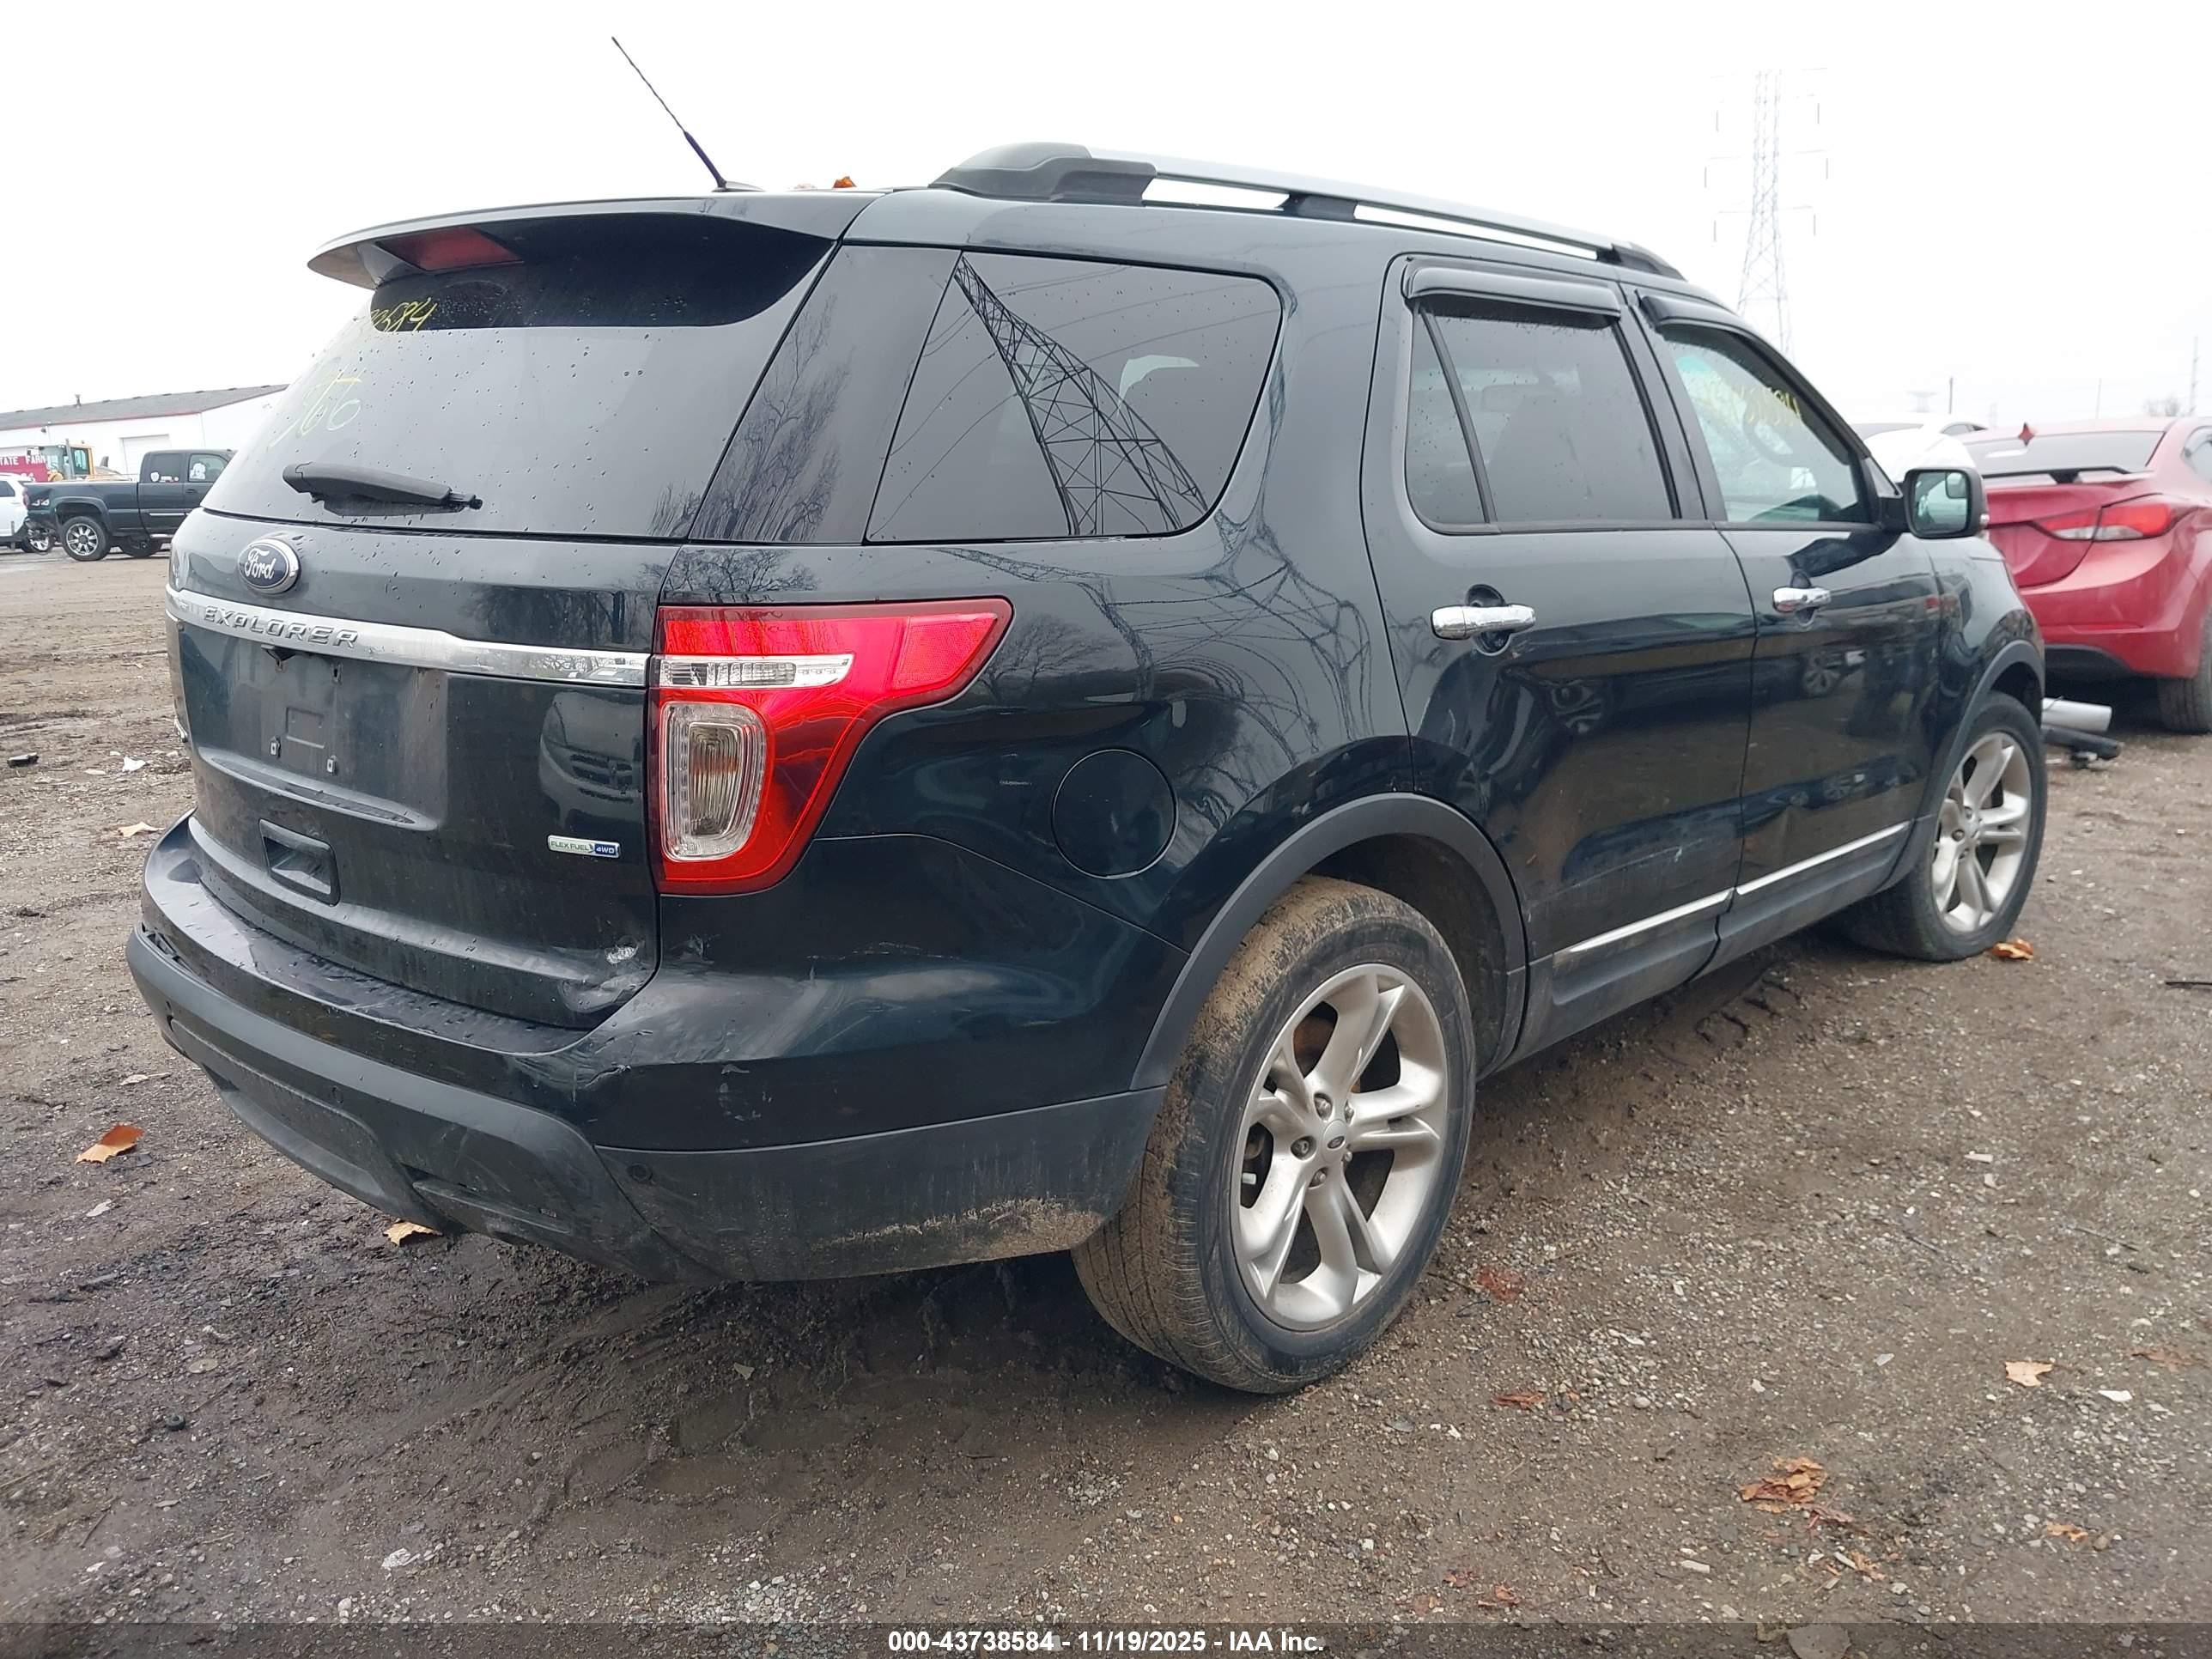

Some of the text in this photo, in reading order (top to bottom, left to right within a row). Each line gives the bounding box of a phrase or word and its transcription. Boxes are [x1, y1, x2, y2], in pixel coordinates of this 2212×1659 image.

[0, 456, 20, 466] TATE
[244, 547, 276, 580] Ford
[204, 605, 359, 648] EXPLORER
[550, 841, 569, 849] FLEX
